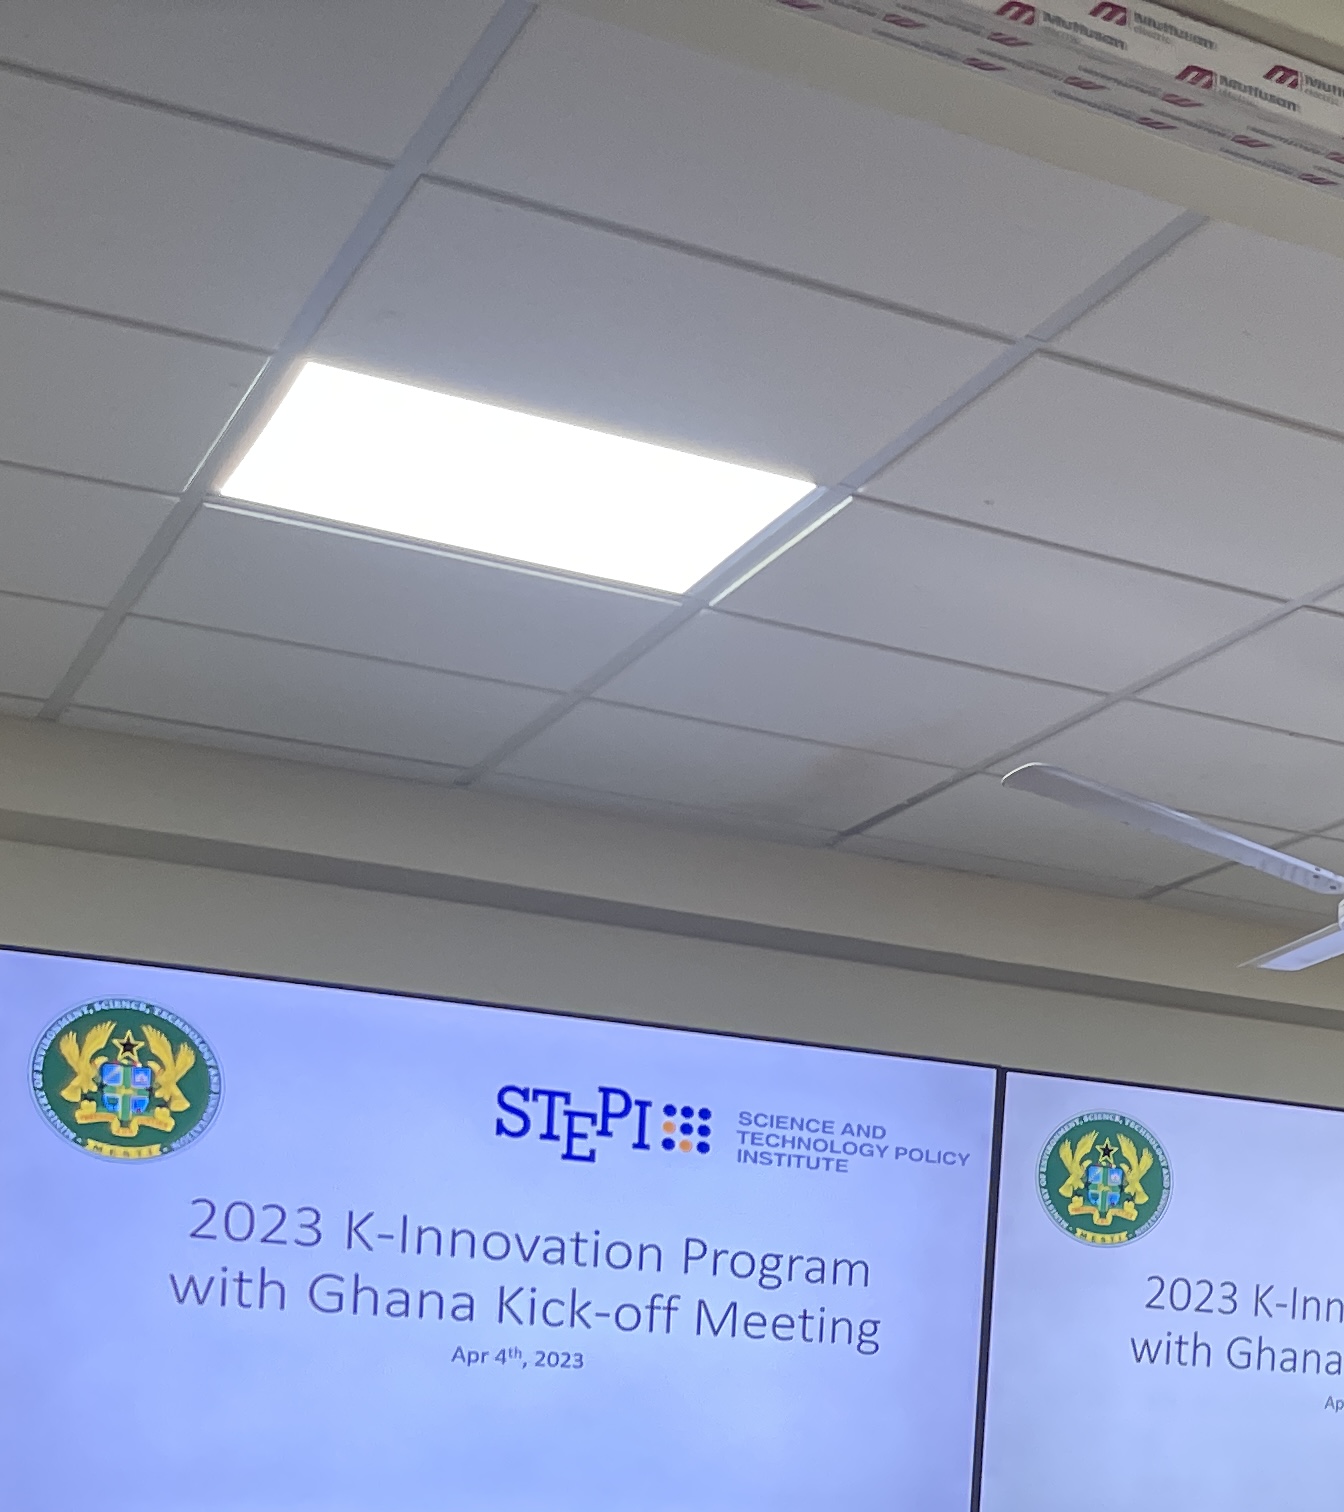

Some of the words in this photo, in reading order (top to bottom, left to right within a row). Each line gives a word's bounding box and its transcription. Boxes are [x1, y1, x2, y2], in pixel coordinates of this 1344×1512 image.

[495, 1084, 653, 1163] STEPI
[737, 1110, 836, 1136] SCIENCE
[840, 1122, 888, 1141] AND
[735, 1129, 890, 1160] TECHNOLOGY
[893, 1146, 972, 1168] POLICY
[735, 1149, 850, 1174] INSTITUTE
[190, 1198, 323, 1249] 2023
[345, 1210, 664, 1274] K-Innovation
[682, 1237, 872, 1294] Program
[169, 1266, 288, 1313] with
[308, 1273, 476, 1327] Ghana
[497, 1285, 681, 1337] Kick-off
[694, 1299, 883, 1356] Meeting
[1144, 1274, 1239, 1317] 2023
[450, 1345, 490, 1371] Apr
[494, 1345, 529, 1372] 4th,
[533, 1348, 585, 1371] 2023
[1130, 1332, 1212, 1369] with
[1226, 1336, 1343, 1378] Ghana
